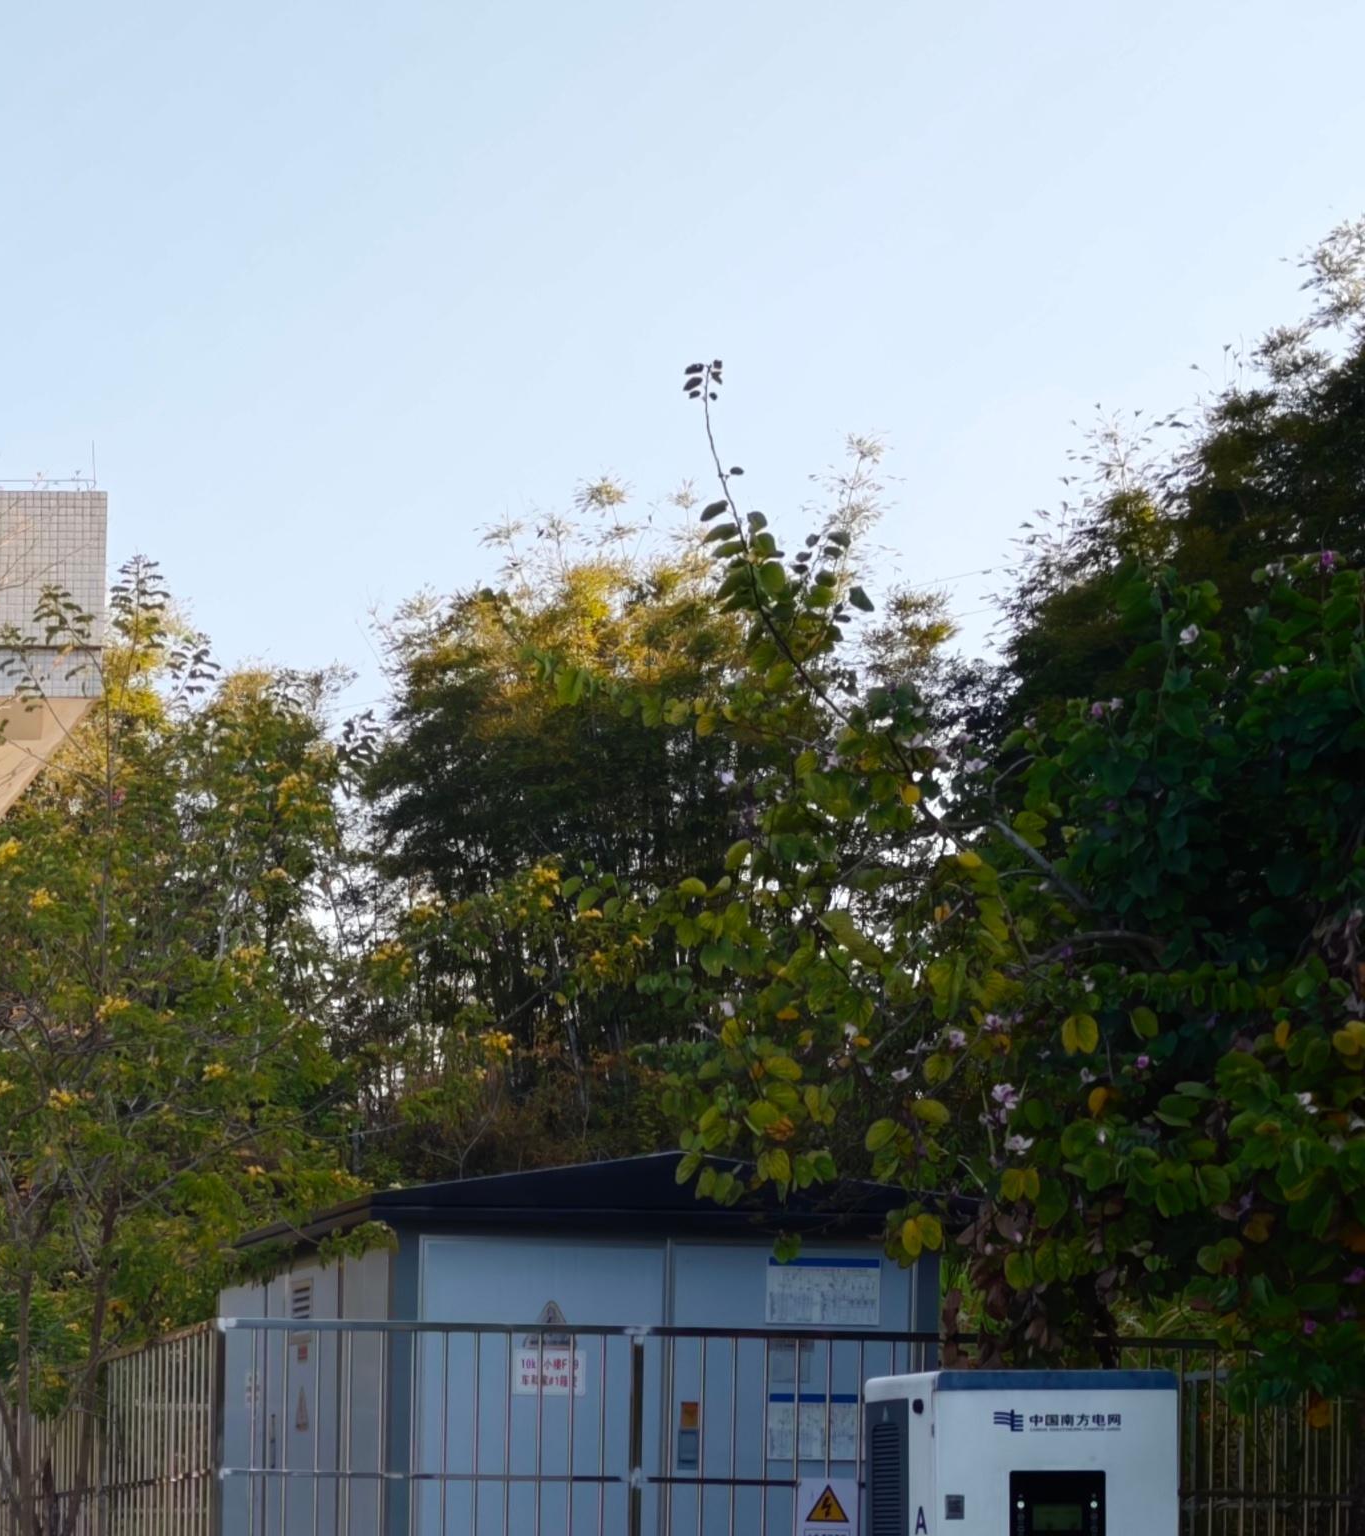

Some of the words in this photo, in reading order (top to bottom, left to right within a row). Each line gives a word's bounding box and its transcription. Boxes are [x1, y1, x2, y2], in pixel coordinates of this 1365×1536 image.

[1029, 1413, 1122, 1427] 中国南方电网
[914, 1505, 928, 1536] A
